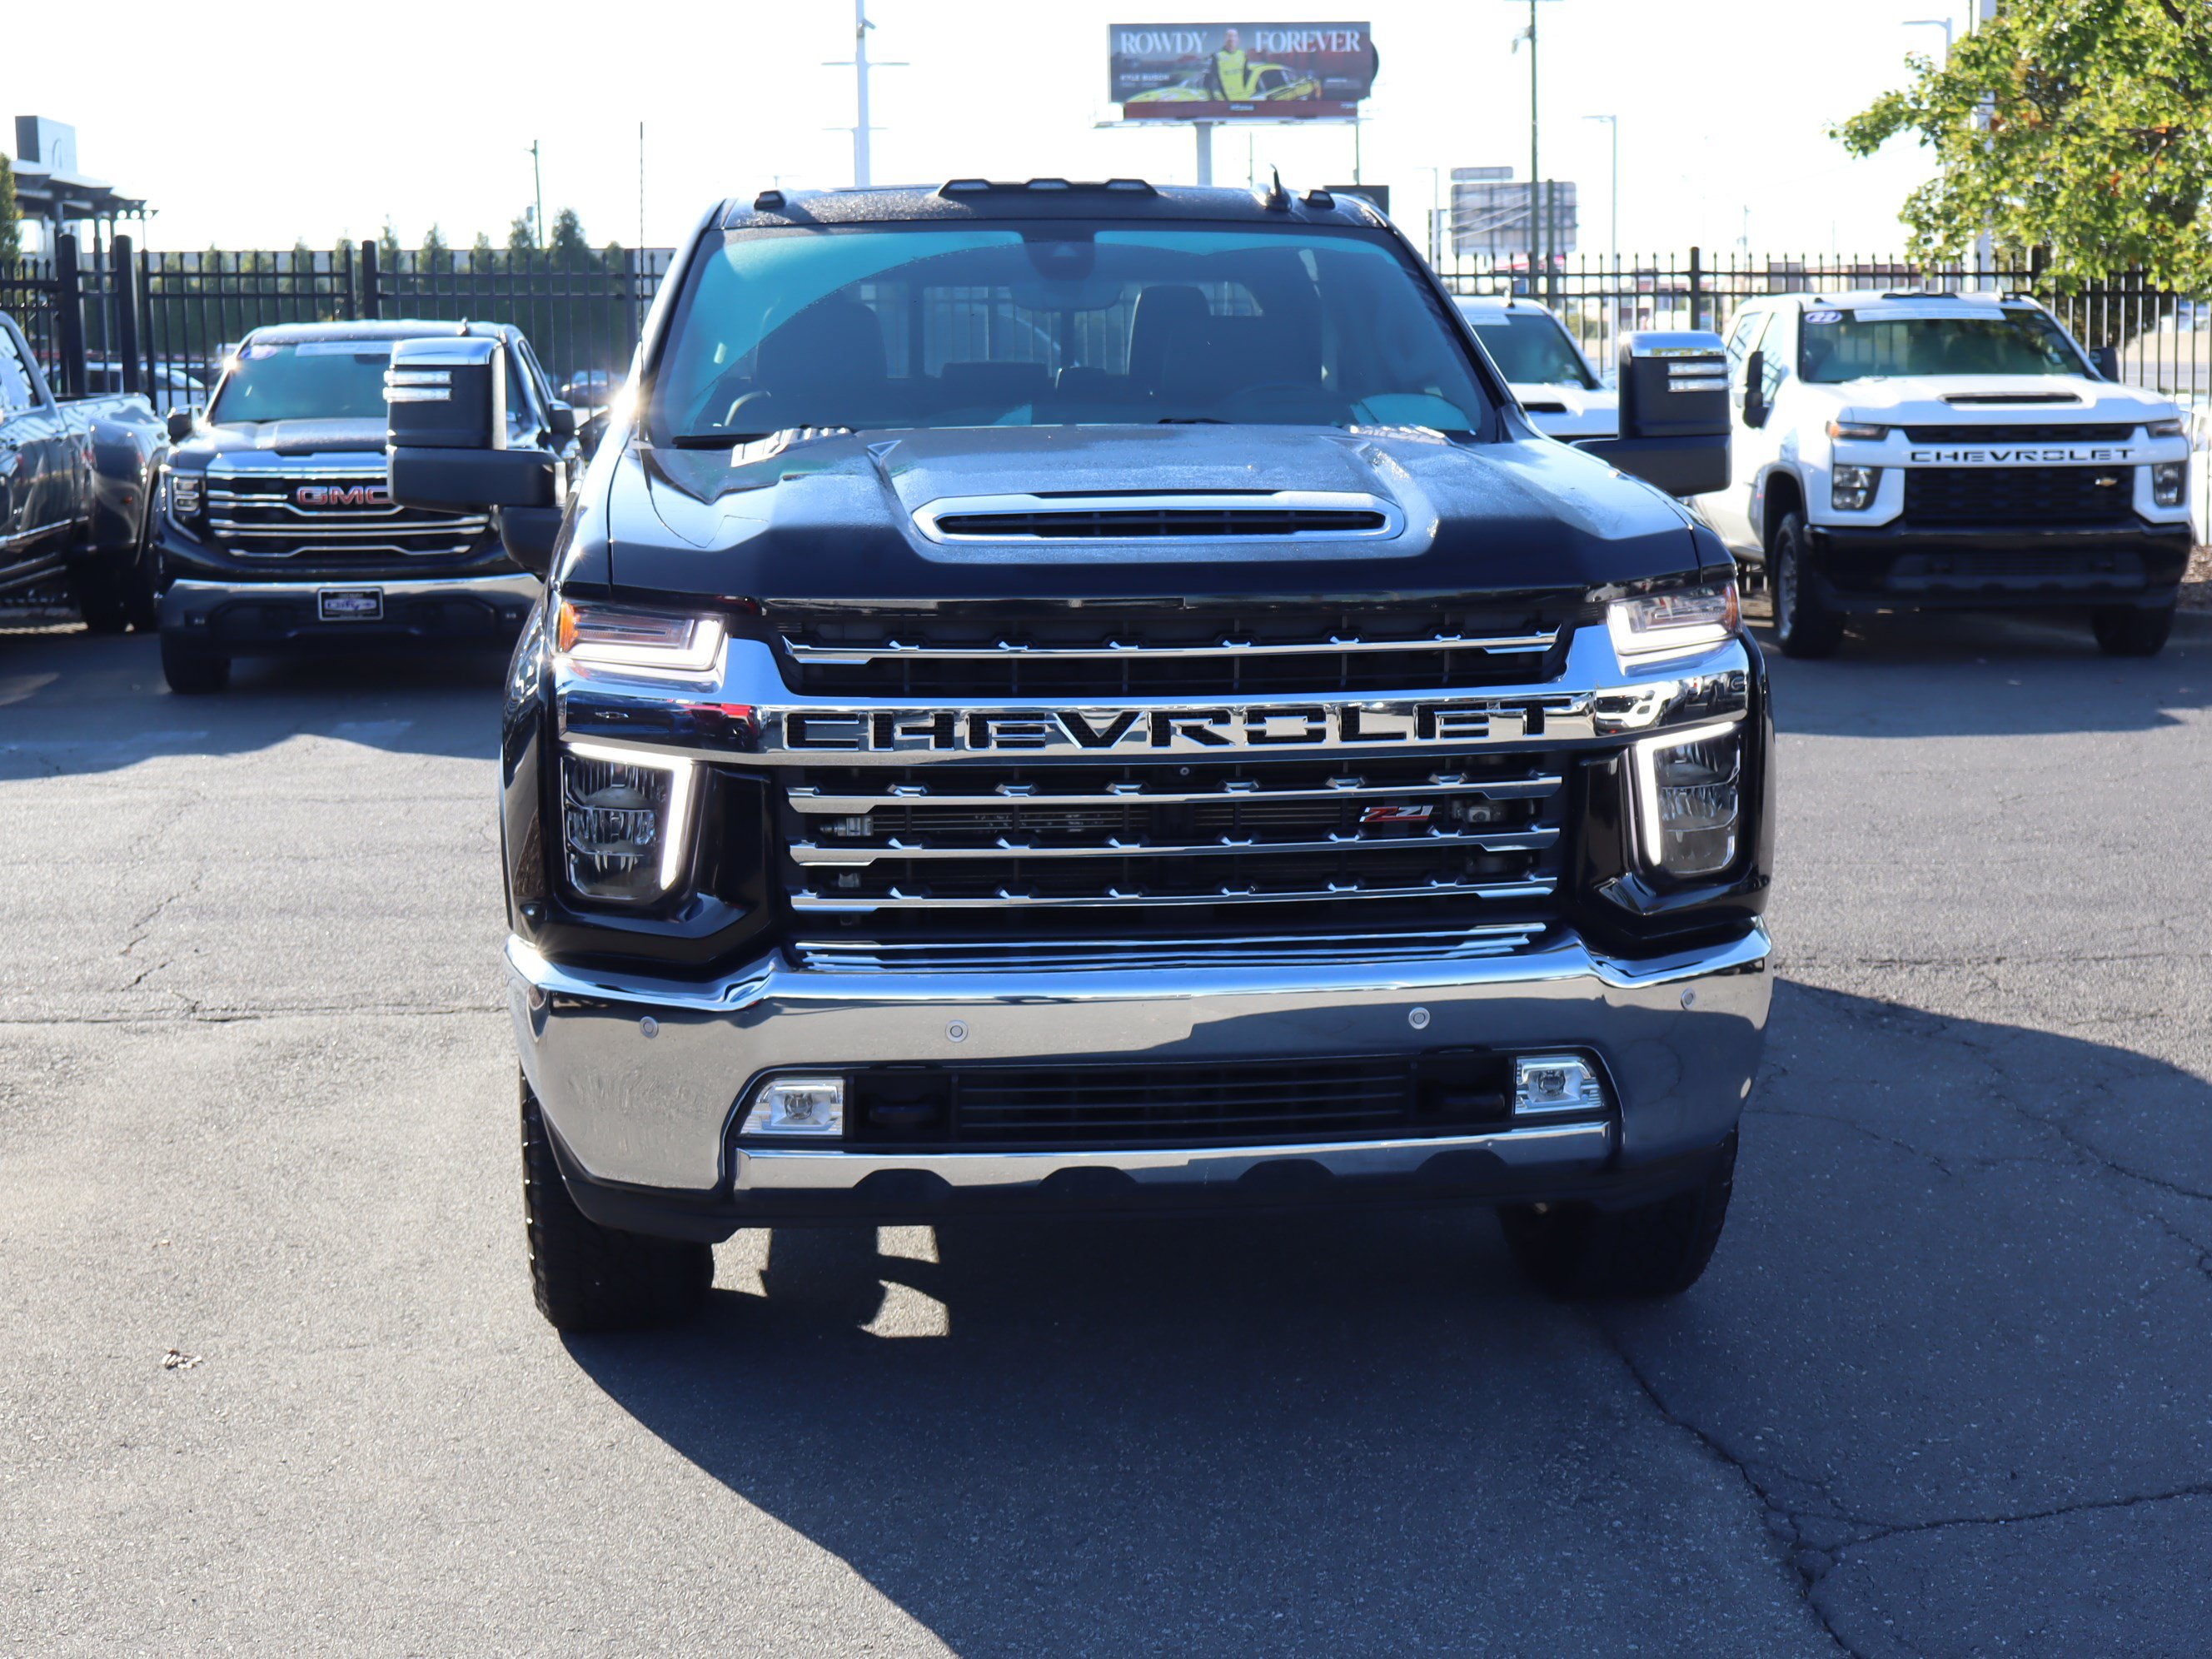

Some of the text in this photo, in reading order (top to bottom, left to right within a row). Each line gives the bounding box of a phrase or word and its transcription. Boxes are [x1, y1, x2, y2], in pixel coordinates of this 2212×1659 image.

[1119, 29, 1361, 54] ROWDY FOREVER
[1909, 447, 2136, 464] CHEVROLET
[296, 486, 391, 505] GMC
[783, 696, 1572, 751] CHEVROLET
[1358, 805, 1434, 823] Z71
